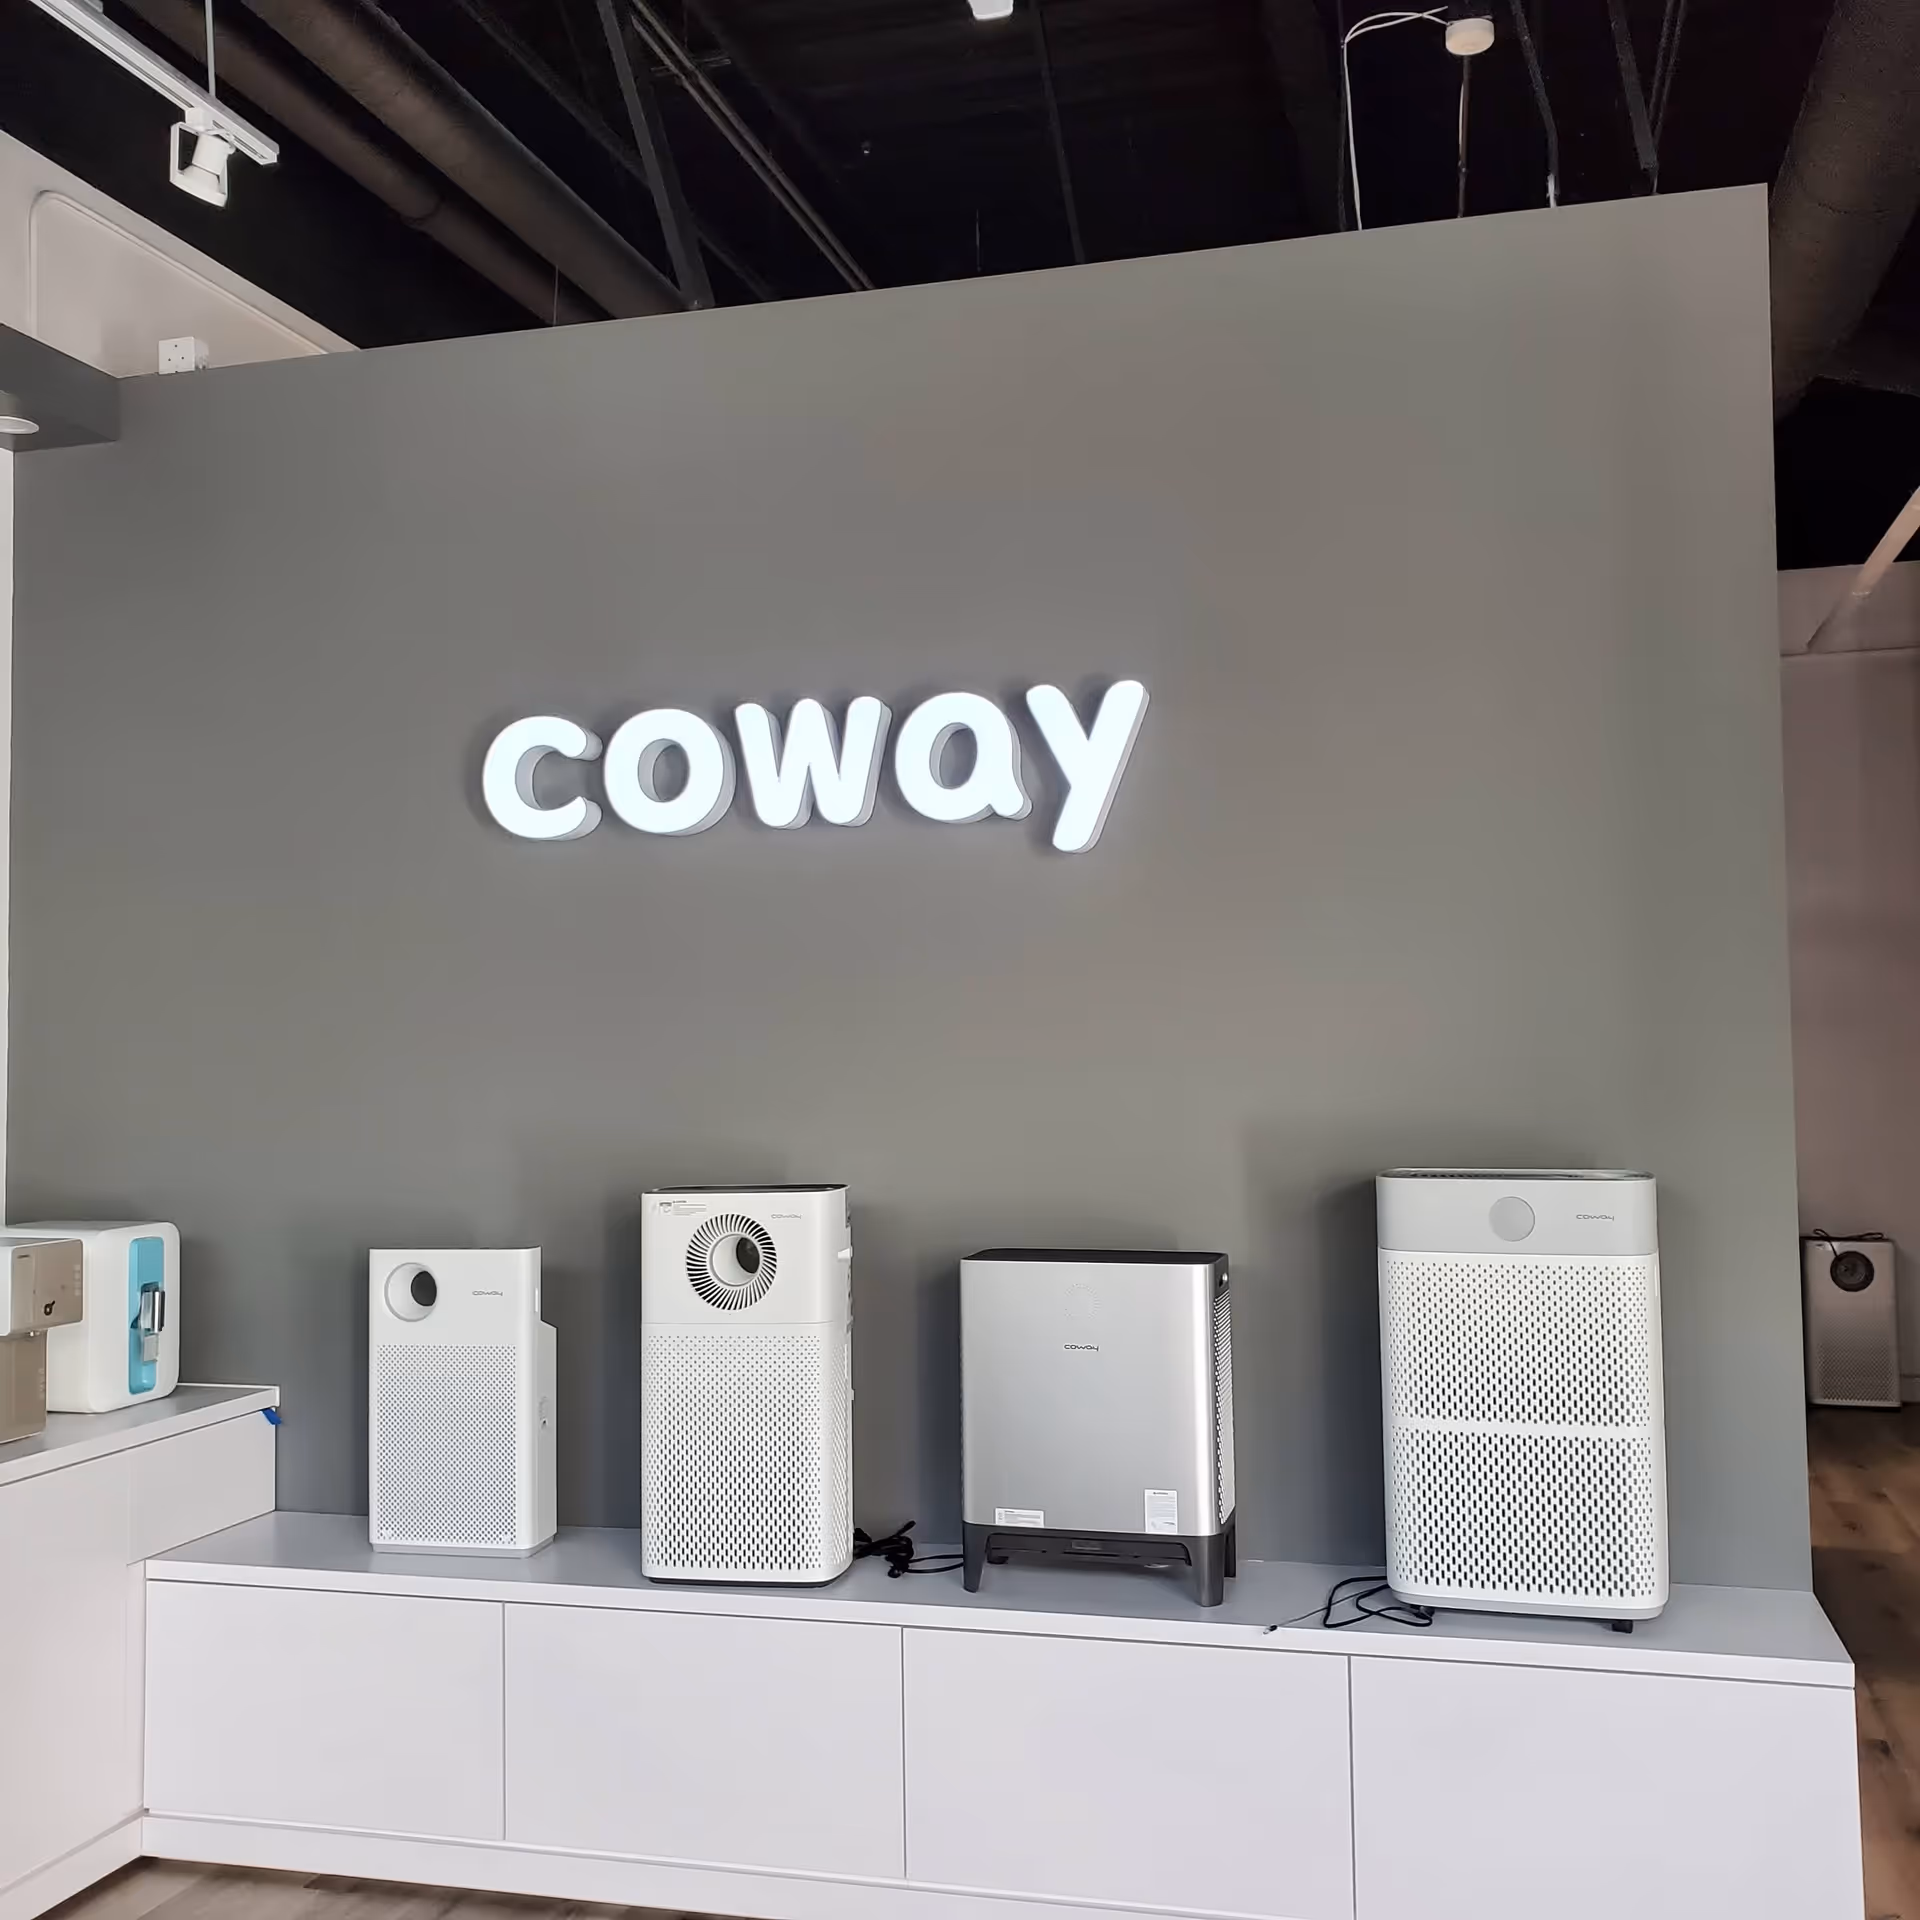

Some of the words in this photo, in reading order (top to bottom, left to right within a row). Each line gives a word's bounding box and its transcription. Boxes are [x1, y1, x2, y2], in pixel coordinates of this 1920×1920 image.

[482, 679, 1149, 854] coway
[1575, 1214, 1615, 1222] coway
[1063, 1344, 1099, 1352] coway
